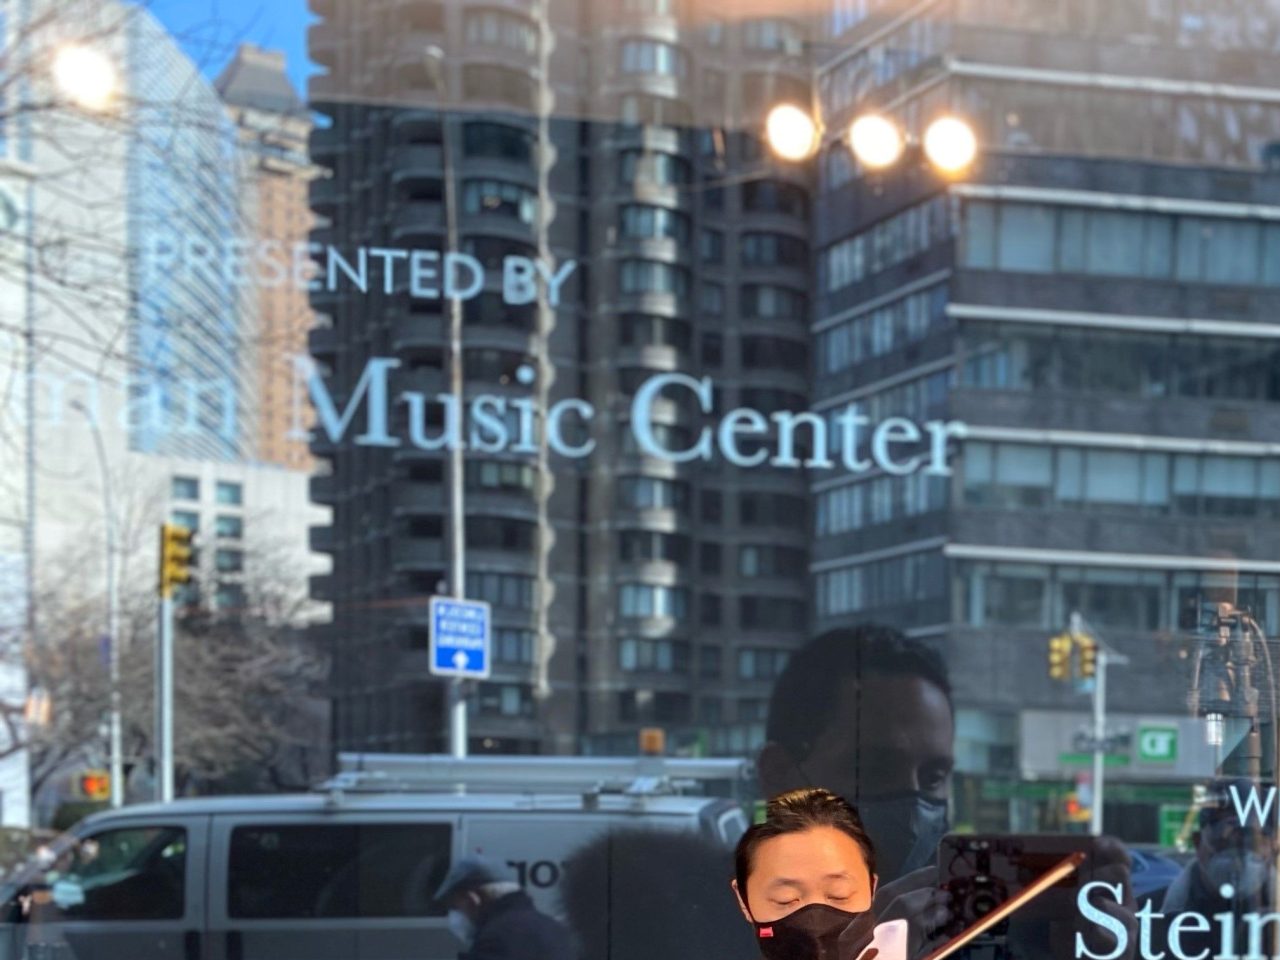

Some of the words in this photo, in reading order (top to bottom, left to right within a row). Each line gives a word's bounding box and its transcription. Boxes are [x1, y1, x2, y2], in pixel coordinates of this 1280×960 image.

[147, 234, 485, 300] PRESENTED
[503, 256, 577, 305] BY
[282, 354, 596, 457] Music
[630, 373, 966, 475] Center
